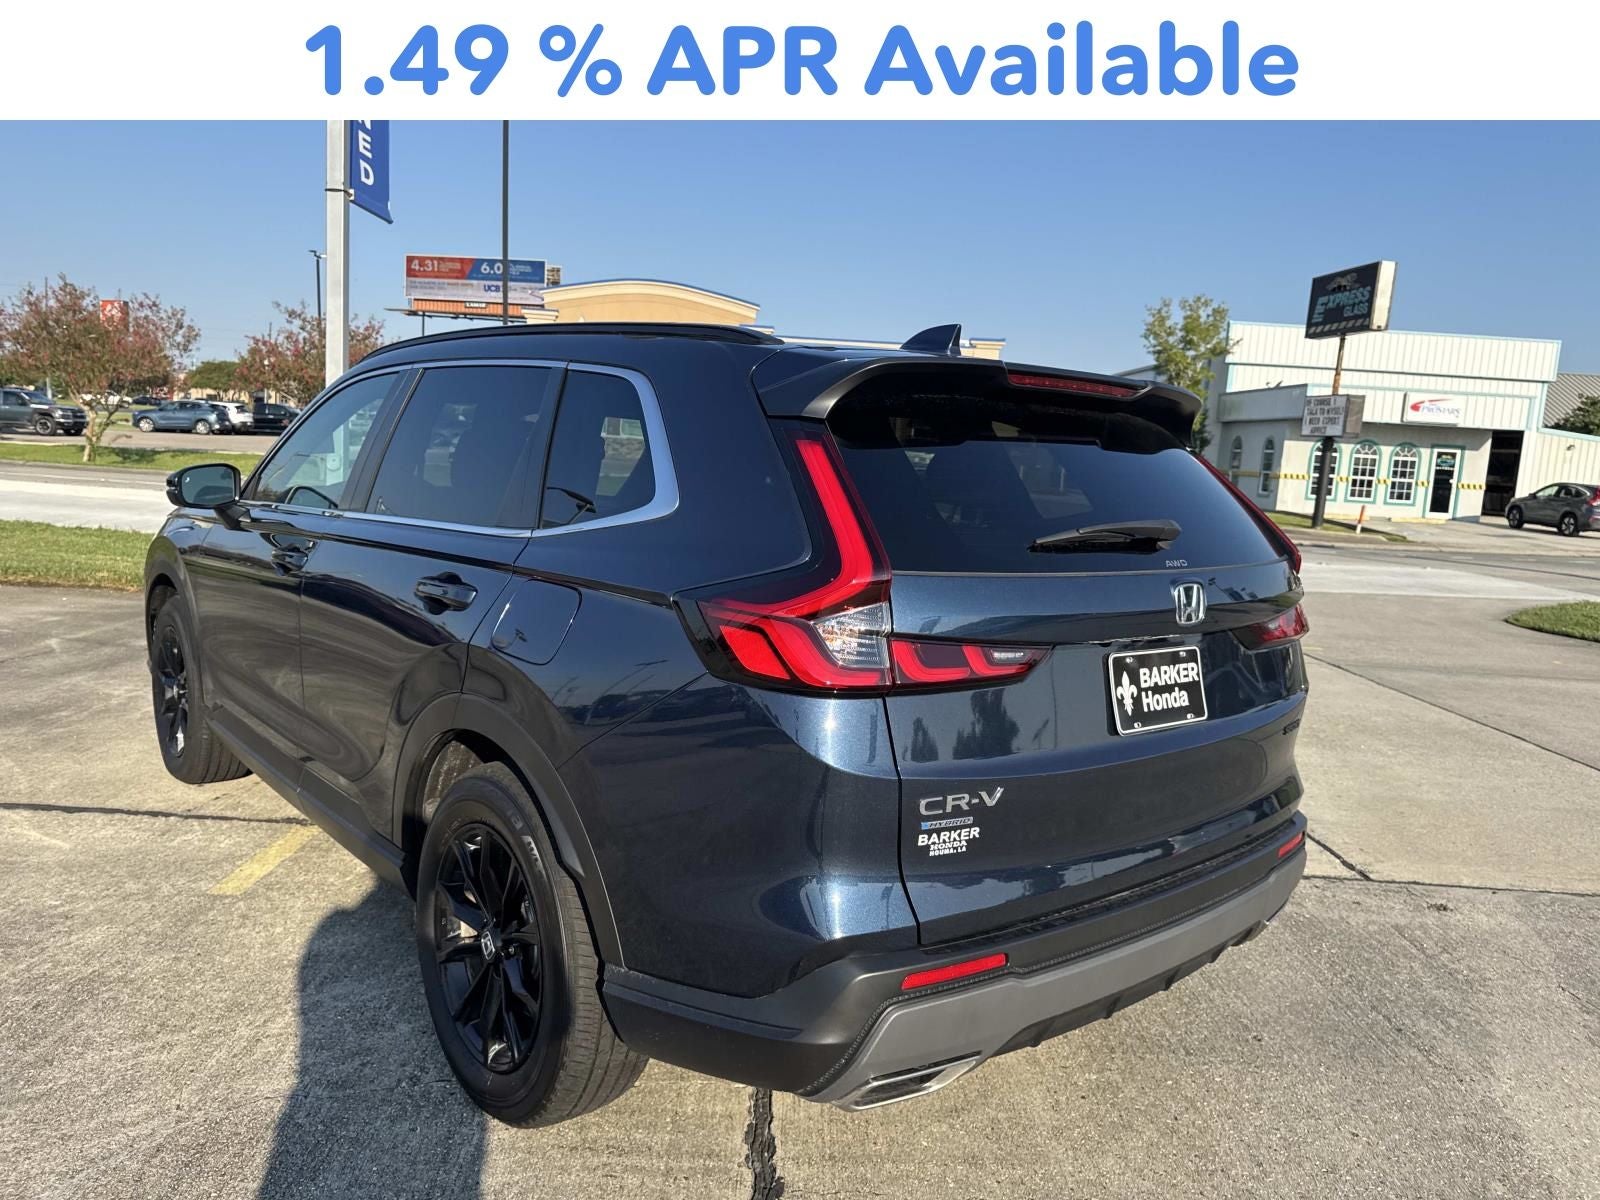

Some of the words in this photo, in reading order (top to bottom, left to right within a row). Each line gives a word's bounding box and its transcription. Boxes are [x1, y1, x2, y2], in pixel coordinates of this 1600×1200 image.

[411, 259, 438, 272] 4.31
[1312, 286, 1372, 323] EXPRESS
[1343, 302, 1369, 317] GLASS
[1165, 559, 1188, 568] AWD
[1139, 662, 1199, 688] BARKER
[1141, 687, 1190, 712] Honda
[919, 786, 1005, 816] CR-V
[928, 818, 972, 829] HYBRID
[918, 827, 980, 846] BARKER
[930, 841, 967, 850] HONDA
